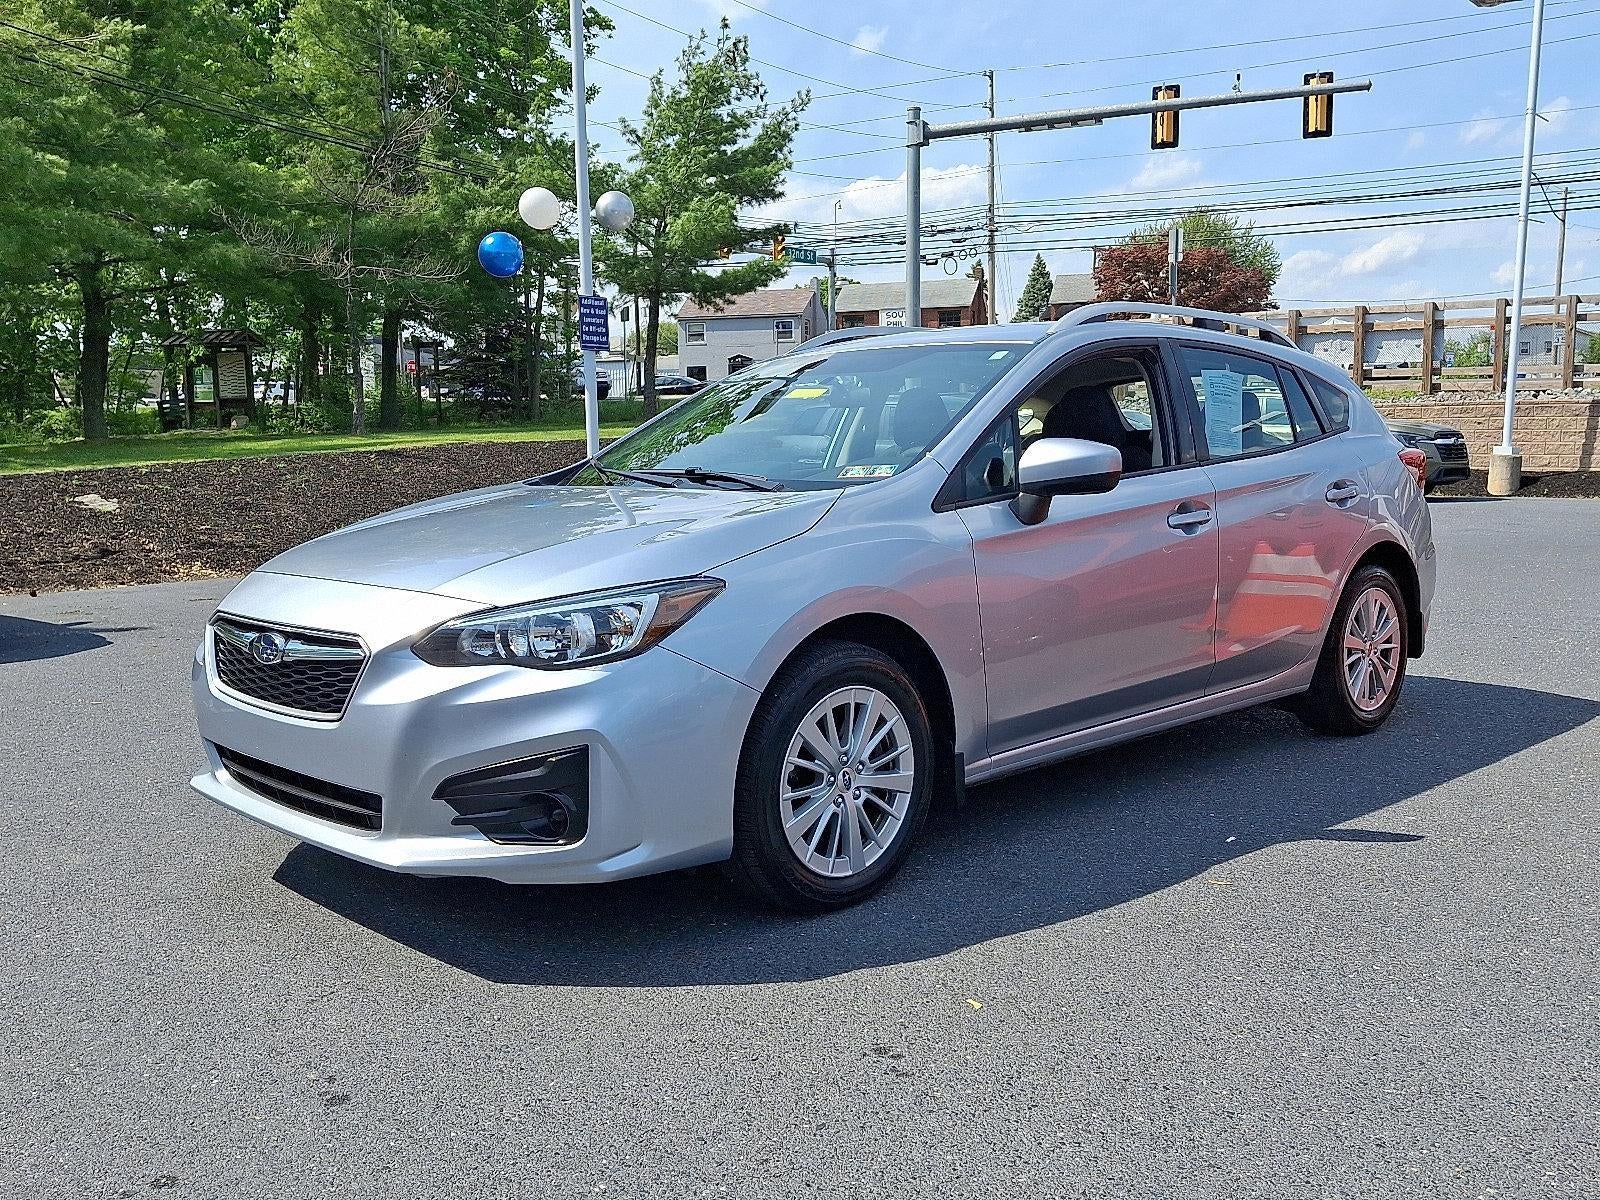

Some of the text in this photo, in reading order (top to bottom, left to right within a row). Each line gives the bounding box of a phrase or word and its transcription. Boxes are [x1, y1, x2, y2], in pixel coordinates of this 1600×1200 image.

[788, 249, 813, 260] 32nd St
[581, 298, 605, 306] Additional
[580, 306, 590, 314] New
[583, 316, 604, 325] Inventory
[582, 333, 599, 342] Storage
